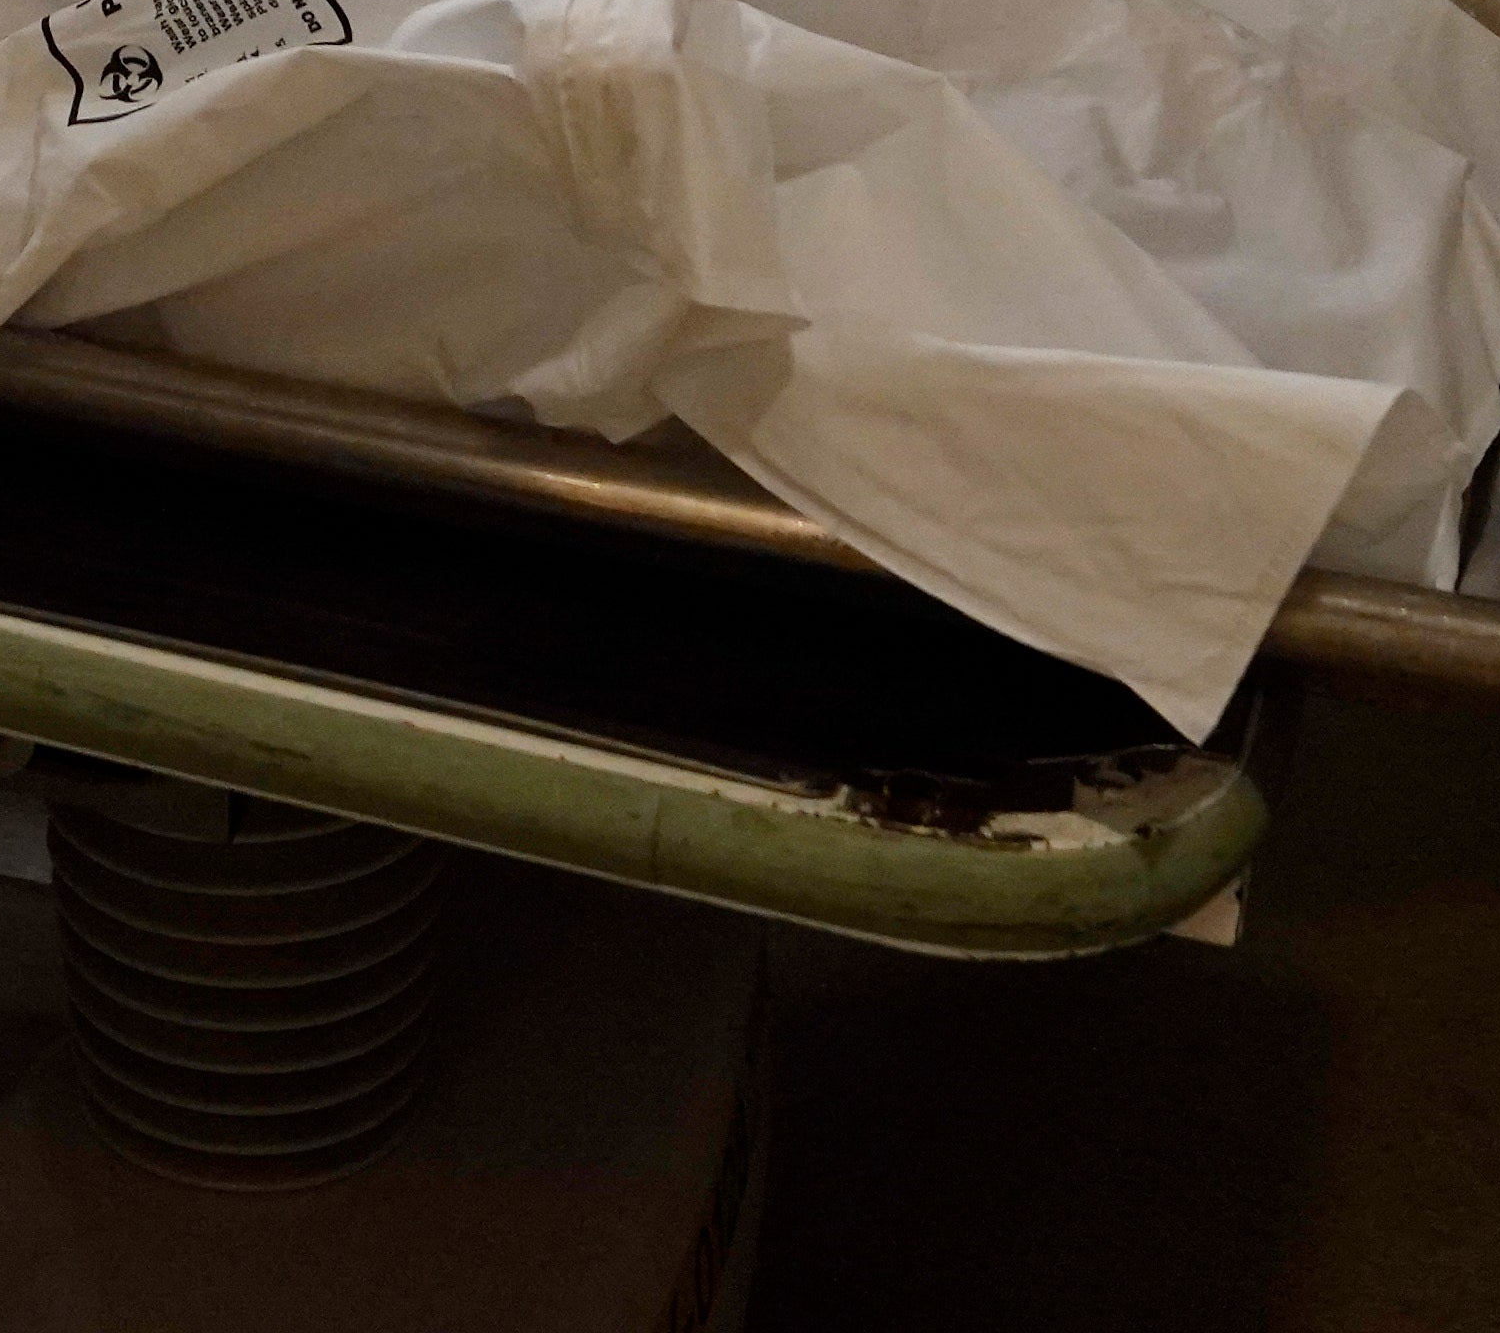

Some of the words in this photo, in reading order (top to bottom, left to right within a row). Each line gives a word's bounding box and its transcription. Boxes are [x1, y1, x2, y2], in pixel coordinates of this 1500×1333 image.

[207, 0, 232, 32] Wear
[301, 10, 322, 33] DO
[160, 20, 185, 54] Wash
[174, 18, 197, 49] Wear
[197, 28, 209, 43] to
